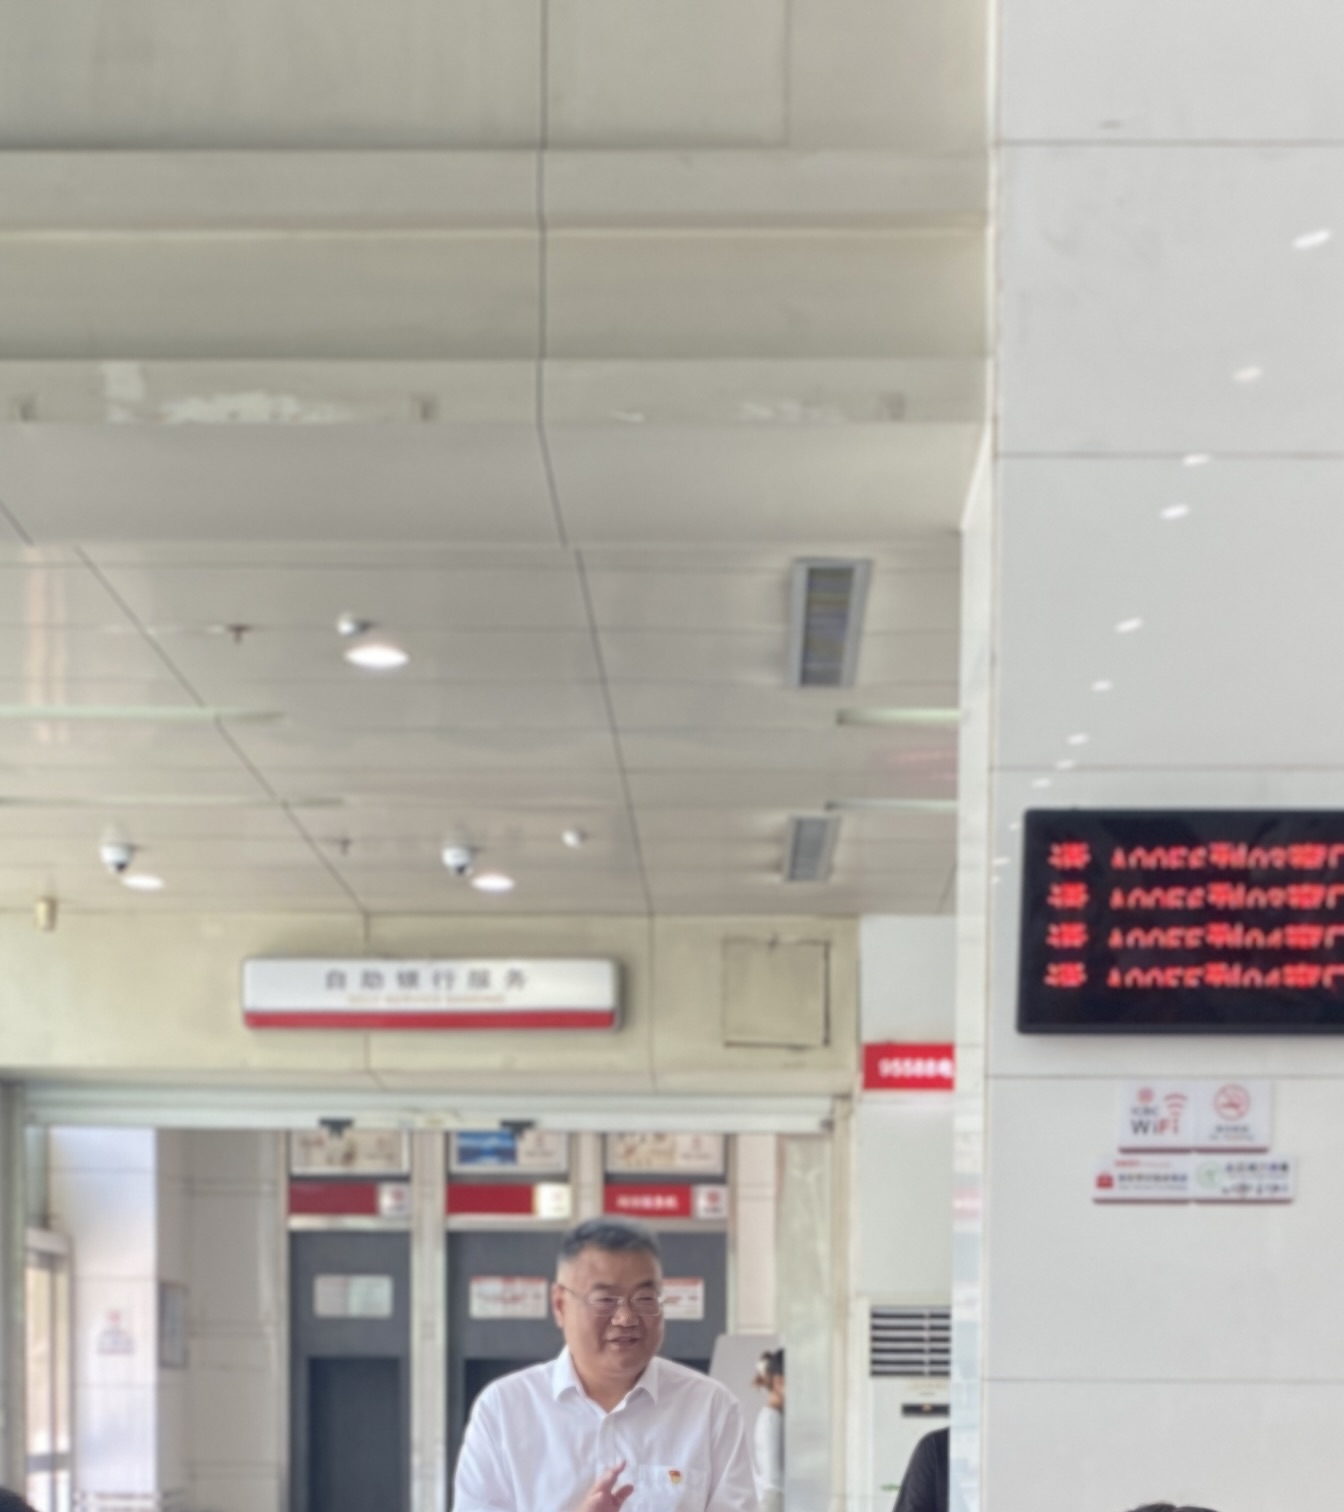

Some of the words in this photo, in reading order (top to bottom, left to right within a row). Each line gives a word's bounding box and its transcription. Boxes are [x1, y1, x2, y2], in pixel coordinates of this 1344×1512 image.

[324, 967, 528, 991] 自助银行服务
[1130, 1118, 1180, 1135] WiFi
